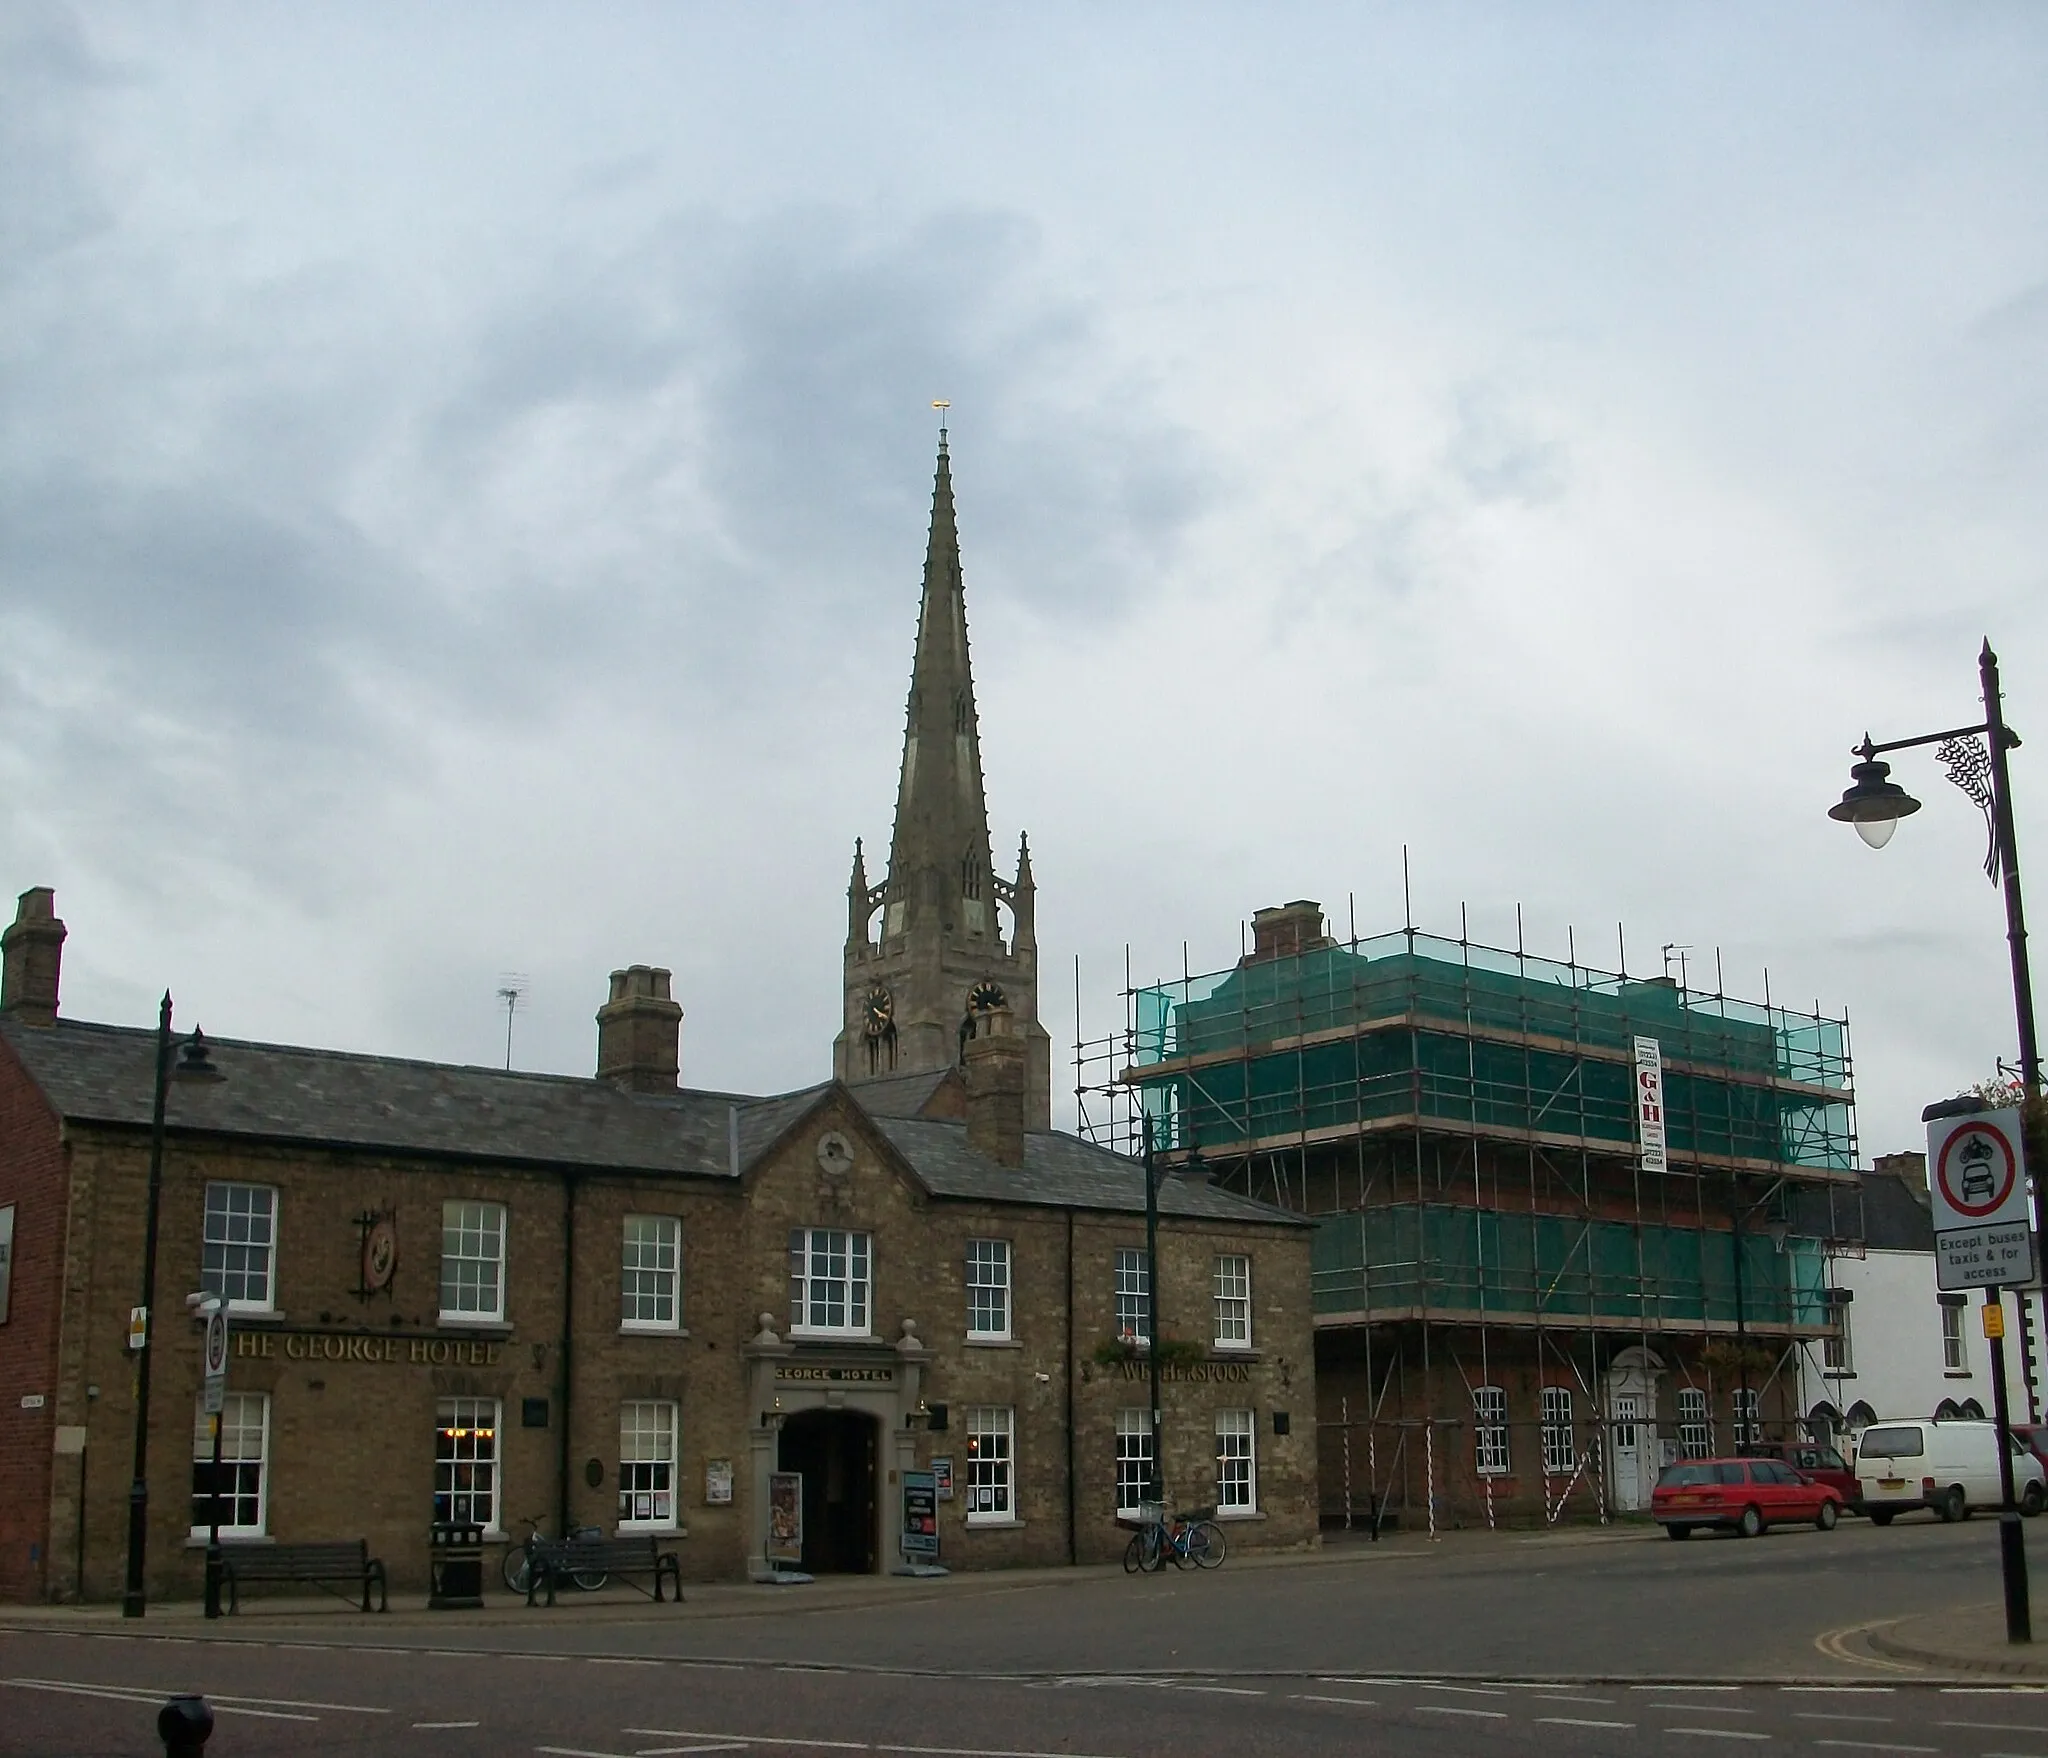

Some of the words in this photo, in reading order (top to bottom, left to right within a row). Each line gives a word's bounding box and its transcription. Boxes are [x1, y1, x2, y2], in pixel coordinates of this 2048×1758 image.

[1640, 1071, 1657, 1090] G
[1643, 1091, 1656, 1103] &
[1642, 1104, 1660, 1122] H
[1940, 1236, 1982, 1251] Except
[1988, 1232, 2025, 1245] buses
[1949, 1251, 1980, 1266] taxis
[1986, 1249, 1995, 1261] &
[2002, 1247, 2019, 1259] for
[1964, 1267, 2007, 1280] access
[234, 1333, 276, 1358] HE
[286, 1335, 399, 1362] GEORGE
[409, 1339, 500, 1365] HOTEL
[775, 1367, 831, 1380] GEORGE
[841, 1369, 890, 1380] HOTEL
[1122, 1361, 1249, 1383] WEHERSPOON
